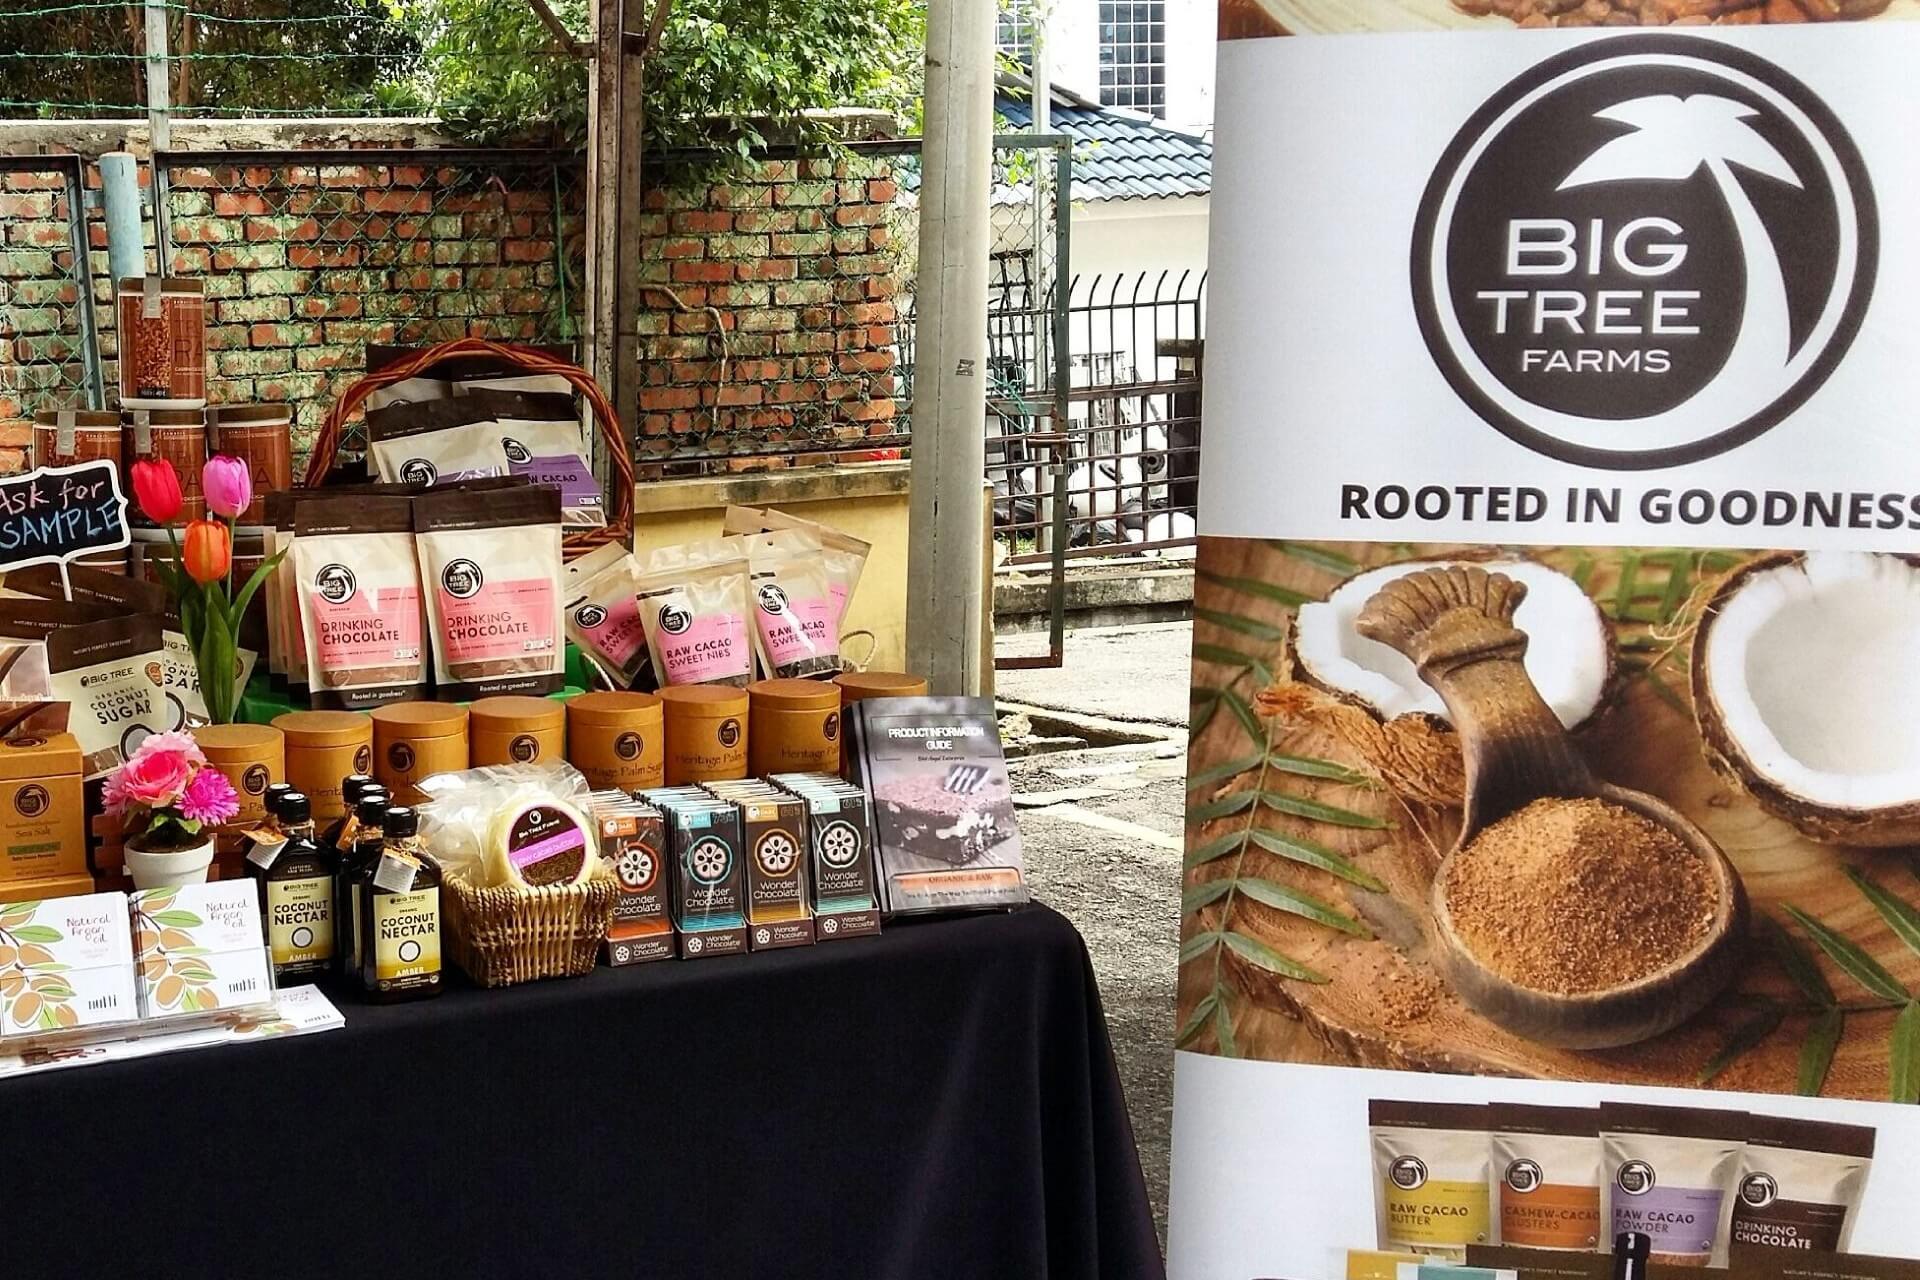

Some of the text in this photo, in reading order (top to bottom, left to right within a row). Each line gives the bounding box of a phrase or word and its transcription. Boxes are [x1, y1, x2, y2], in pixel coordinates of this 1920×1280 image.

[1506, 217, 1688, 277] BIG
[1477, 290, 1700, 335] TREE
[1521, 348, 1671, 374] FARMS
[542, 474, 577, 483] CACAO
[0, 478, 104, 515] Ask for
[1340, 484, 1549, 523] ROOTED
[1566, 488, 1621, 523] IN
[0, 496, 121, 549] SAMPLE
[321, 618, 384, 633] DRINKING
[448, 611, 512, 628] DRINKING
[323, 630, 399, 645] CHOCOLATE
[449, 622, 529, 640] CHOCOLATE
[768, 621, 825, 639] RAW ACAO
[666, 638, 732, 659] RAW CACAO
[772, 635, 801, 648] SWEE
[669, 649, 731, 669] SWEET NIBS
[90, 667, 134, 684] BIG TREE
[90, 688, 149, 711] COCONUT
[97, 699, 152, 724] SUGAR
[888, 726, 984, 739] PRODUCT INFORMATION
[925, 740, 952, 750] GUIDE
[824, 871, 859, 881] Wonder
[760, 880, 797, 890] Wonder
[818, 879, 864, 890] Chocolate
[620, 895, 656, 906] Wonder
[692, 888, 730, 898] Wonder
[754, 887, 800, 899] Chocolate
[206, 899, 249, 914] Natural
[274, 900, 329, 914] COCONUT
[686, 896, 735, 907] Chocolate
[274, 909, 329, 925] NECTAR
[613, 903, 661, 916] Chocolate
[67, 914, 111, 928] Natural
[211, 911, 243, 927] Argan
[381, 912, 435, 928] COCONUT
[842, 920, 875, 928] Chocolate
[72, 926, 105, 942] Argan
[381, 923, 435, 940] NECTAR
[774, 926, 800, 934] Wonder
[774, 931, 808, 939] Chocolate
[633, 941, 660, 950] Wonder
[706, 934, 732, 942] Wonder
[706, 940, 740, 948] Chocolate
[634, 946, 668, 956] Chocolate
[396, 966, 424, 977] AMBER
[1390, 1203, 1469, 1217] RAW CACAO
[1504, 1205, 1600, 1220] CASHEW-CACAO
[1616, 1208, 1695, 1224] RAW CACAO
[1391, 1214, 1431, 1226] BUTTER
[1616, 1220, 1669, 1233] POWDER
[1735, 1221, 1797, 1237] DRINKING
[1735, 1232, 1812, 1250] CHOCOLATE
